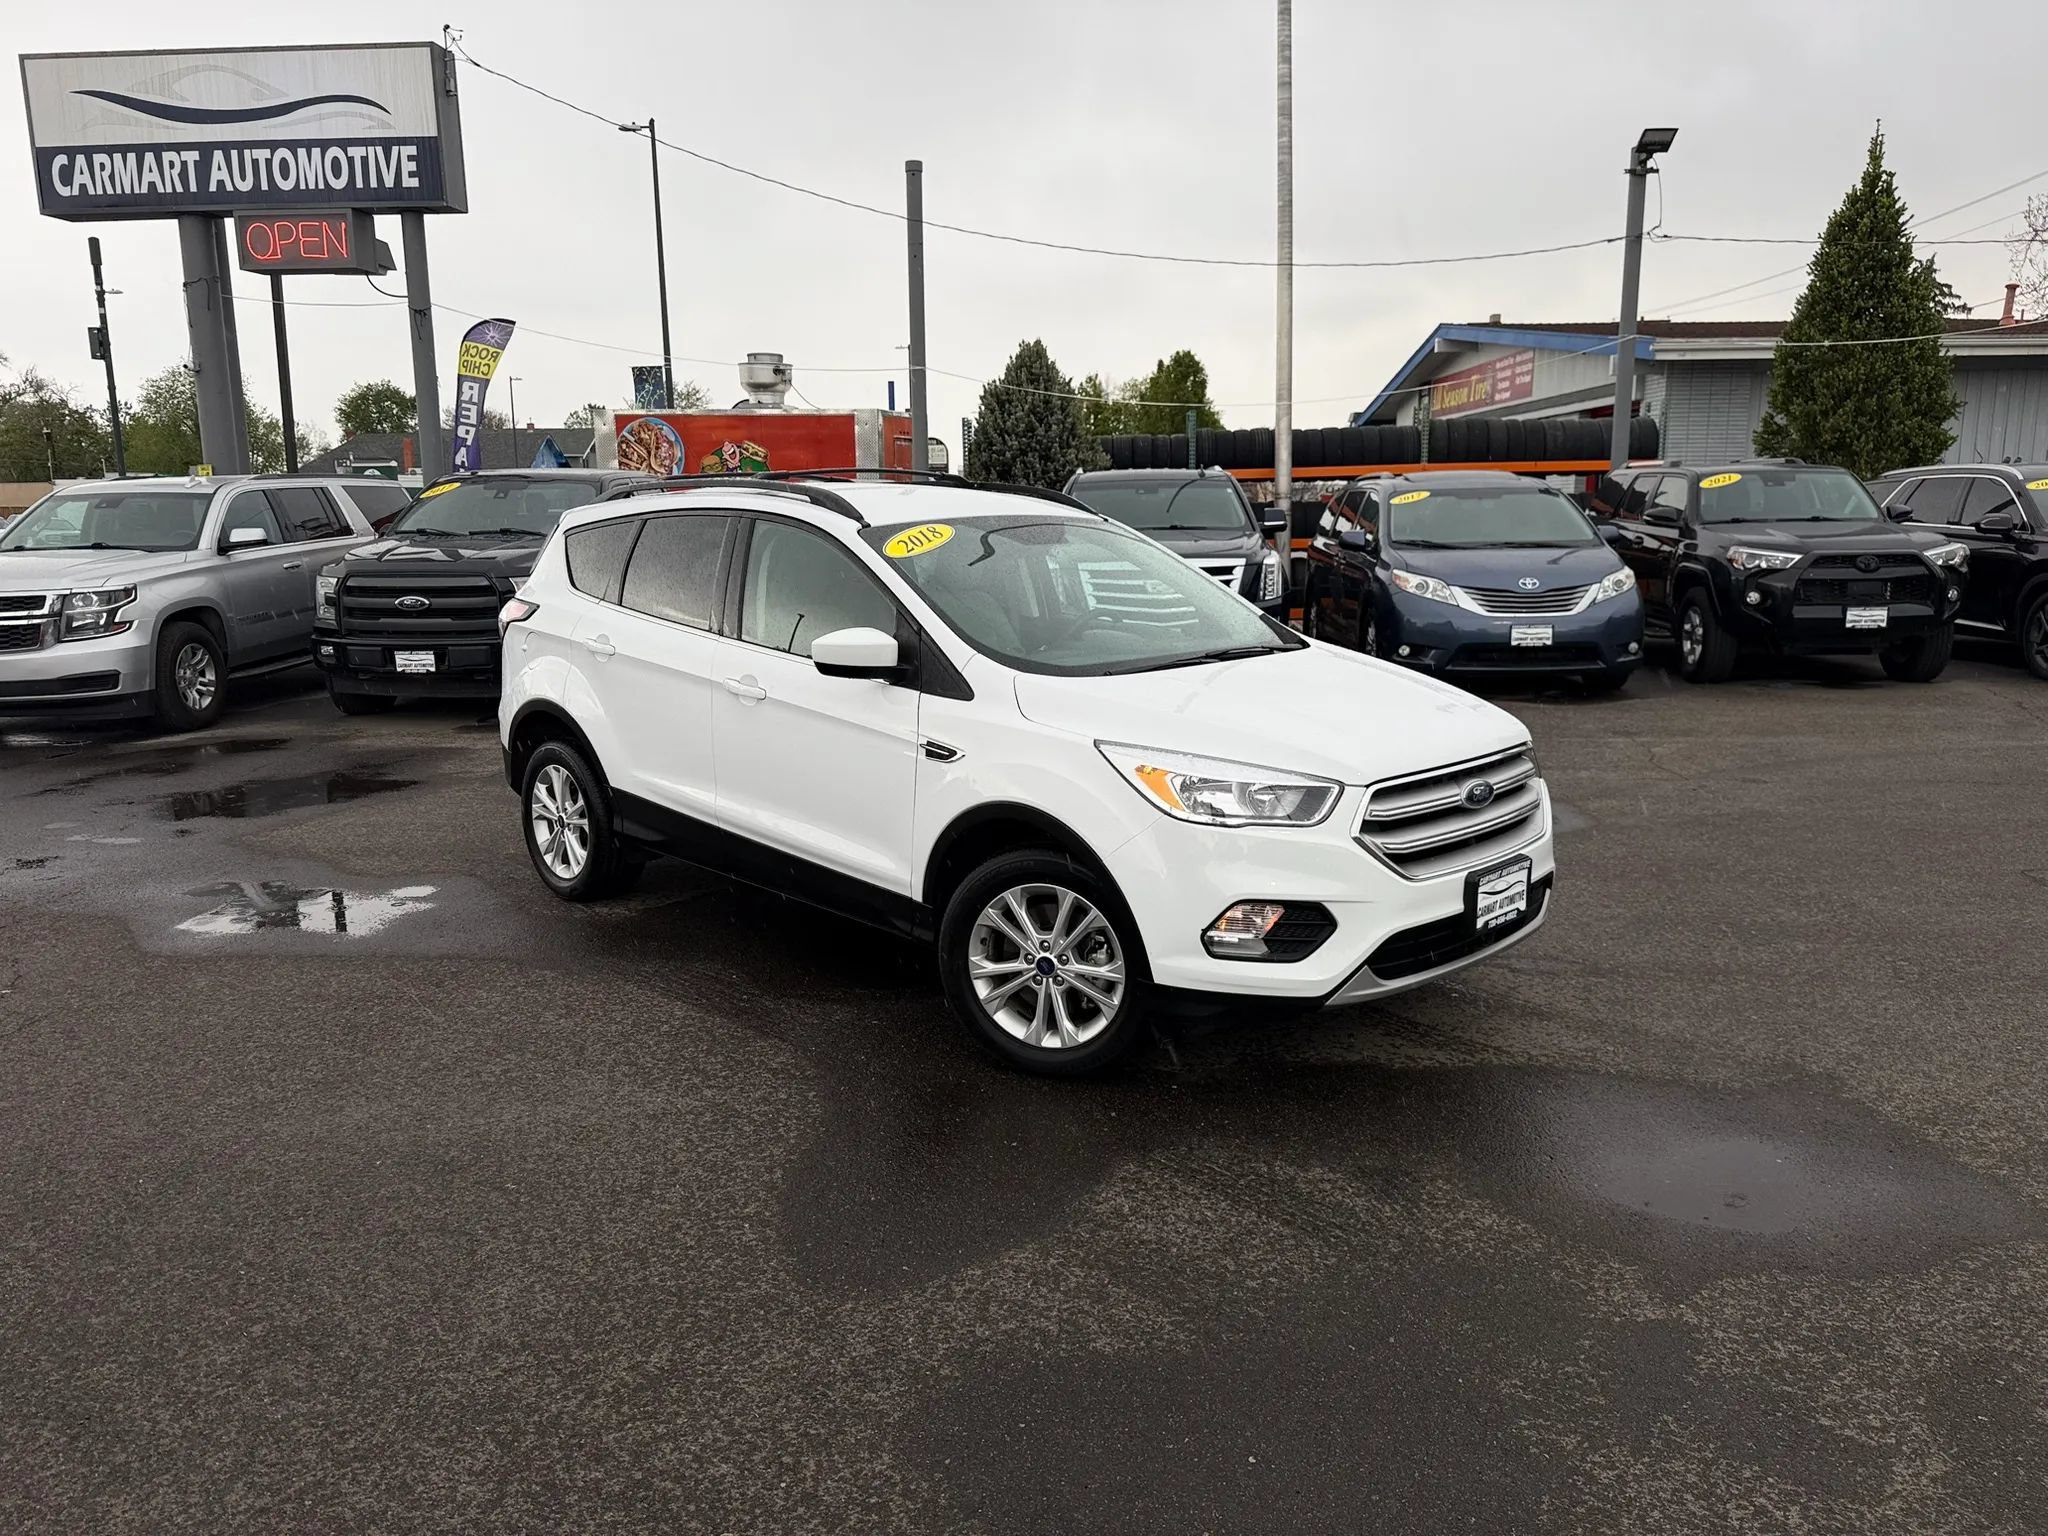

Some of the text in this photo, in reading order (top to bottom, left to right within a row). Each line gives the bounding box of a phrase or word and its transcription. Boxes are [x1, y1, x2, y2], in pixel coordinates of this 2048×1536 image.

[51, 144, 420, 197] CARMART AUTOMOTIVE
[246, 221, 348, 260] OPEN
[1442, 385, 1469, 409] Season
[1469, 374, 1488, 402] Tire
[1708, 474, 1732, 487] 2021
[897, 526, 943, 553] 2018
[1477, 889, 1525, 917] CARMART AUTOMOTIVE
